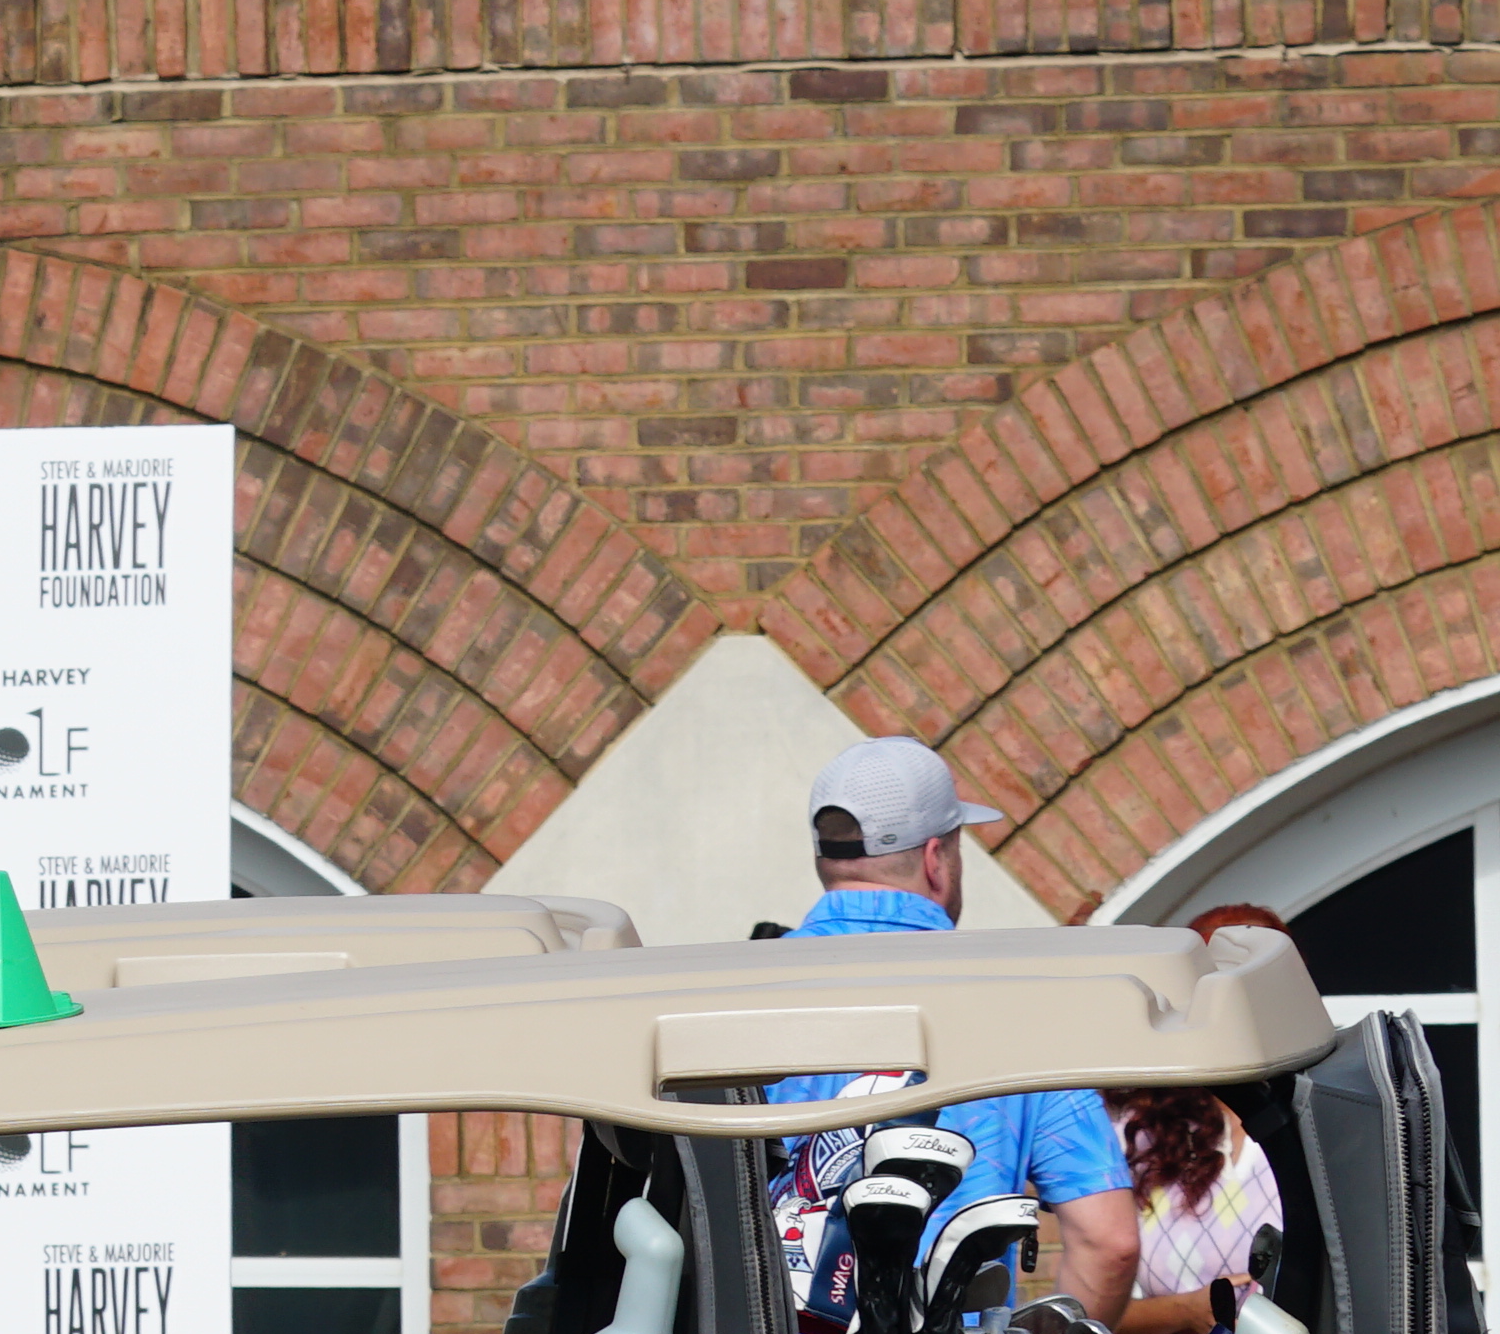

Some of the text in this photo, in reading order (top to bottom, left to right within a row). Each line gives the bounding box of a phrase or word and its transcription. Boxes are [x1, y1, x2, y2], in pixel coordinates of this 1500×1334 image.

[41, 459, 172, 479] STEVE & MARJORIE
[41, 482, 170, 571] HARVEY
[40, 574, 165, 608] FOUNDATION
[3, 669, 89, 686] HARVEY
[903, 1134, 958, 1157] Titleist
[862, 1183, 911, 1198] Titleist
[44, 1243, 173, 1263] STEVE & MARJORIE
[831, 1254, 854, 1305] SWAG
